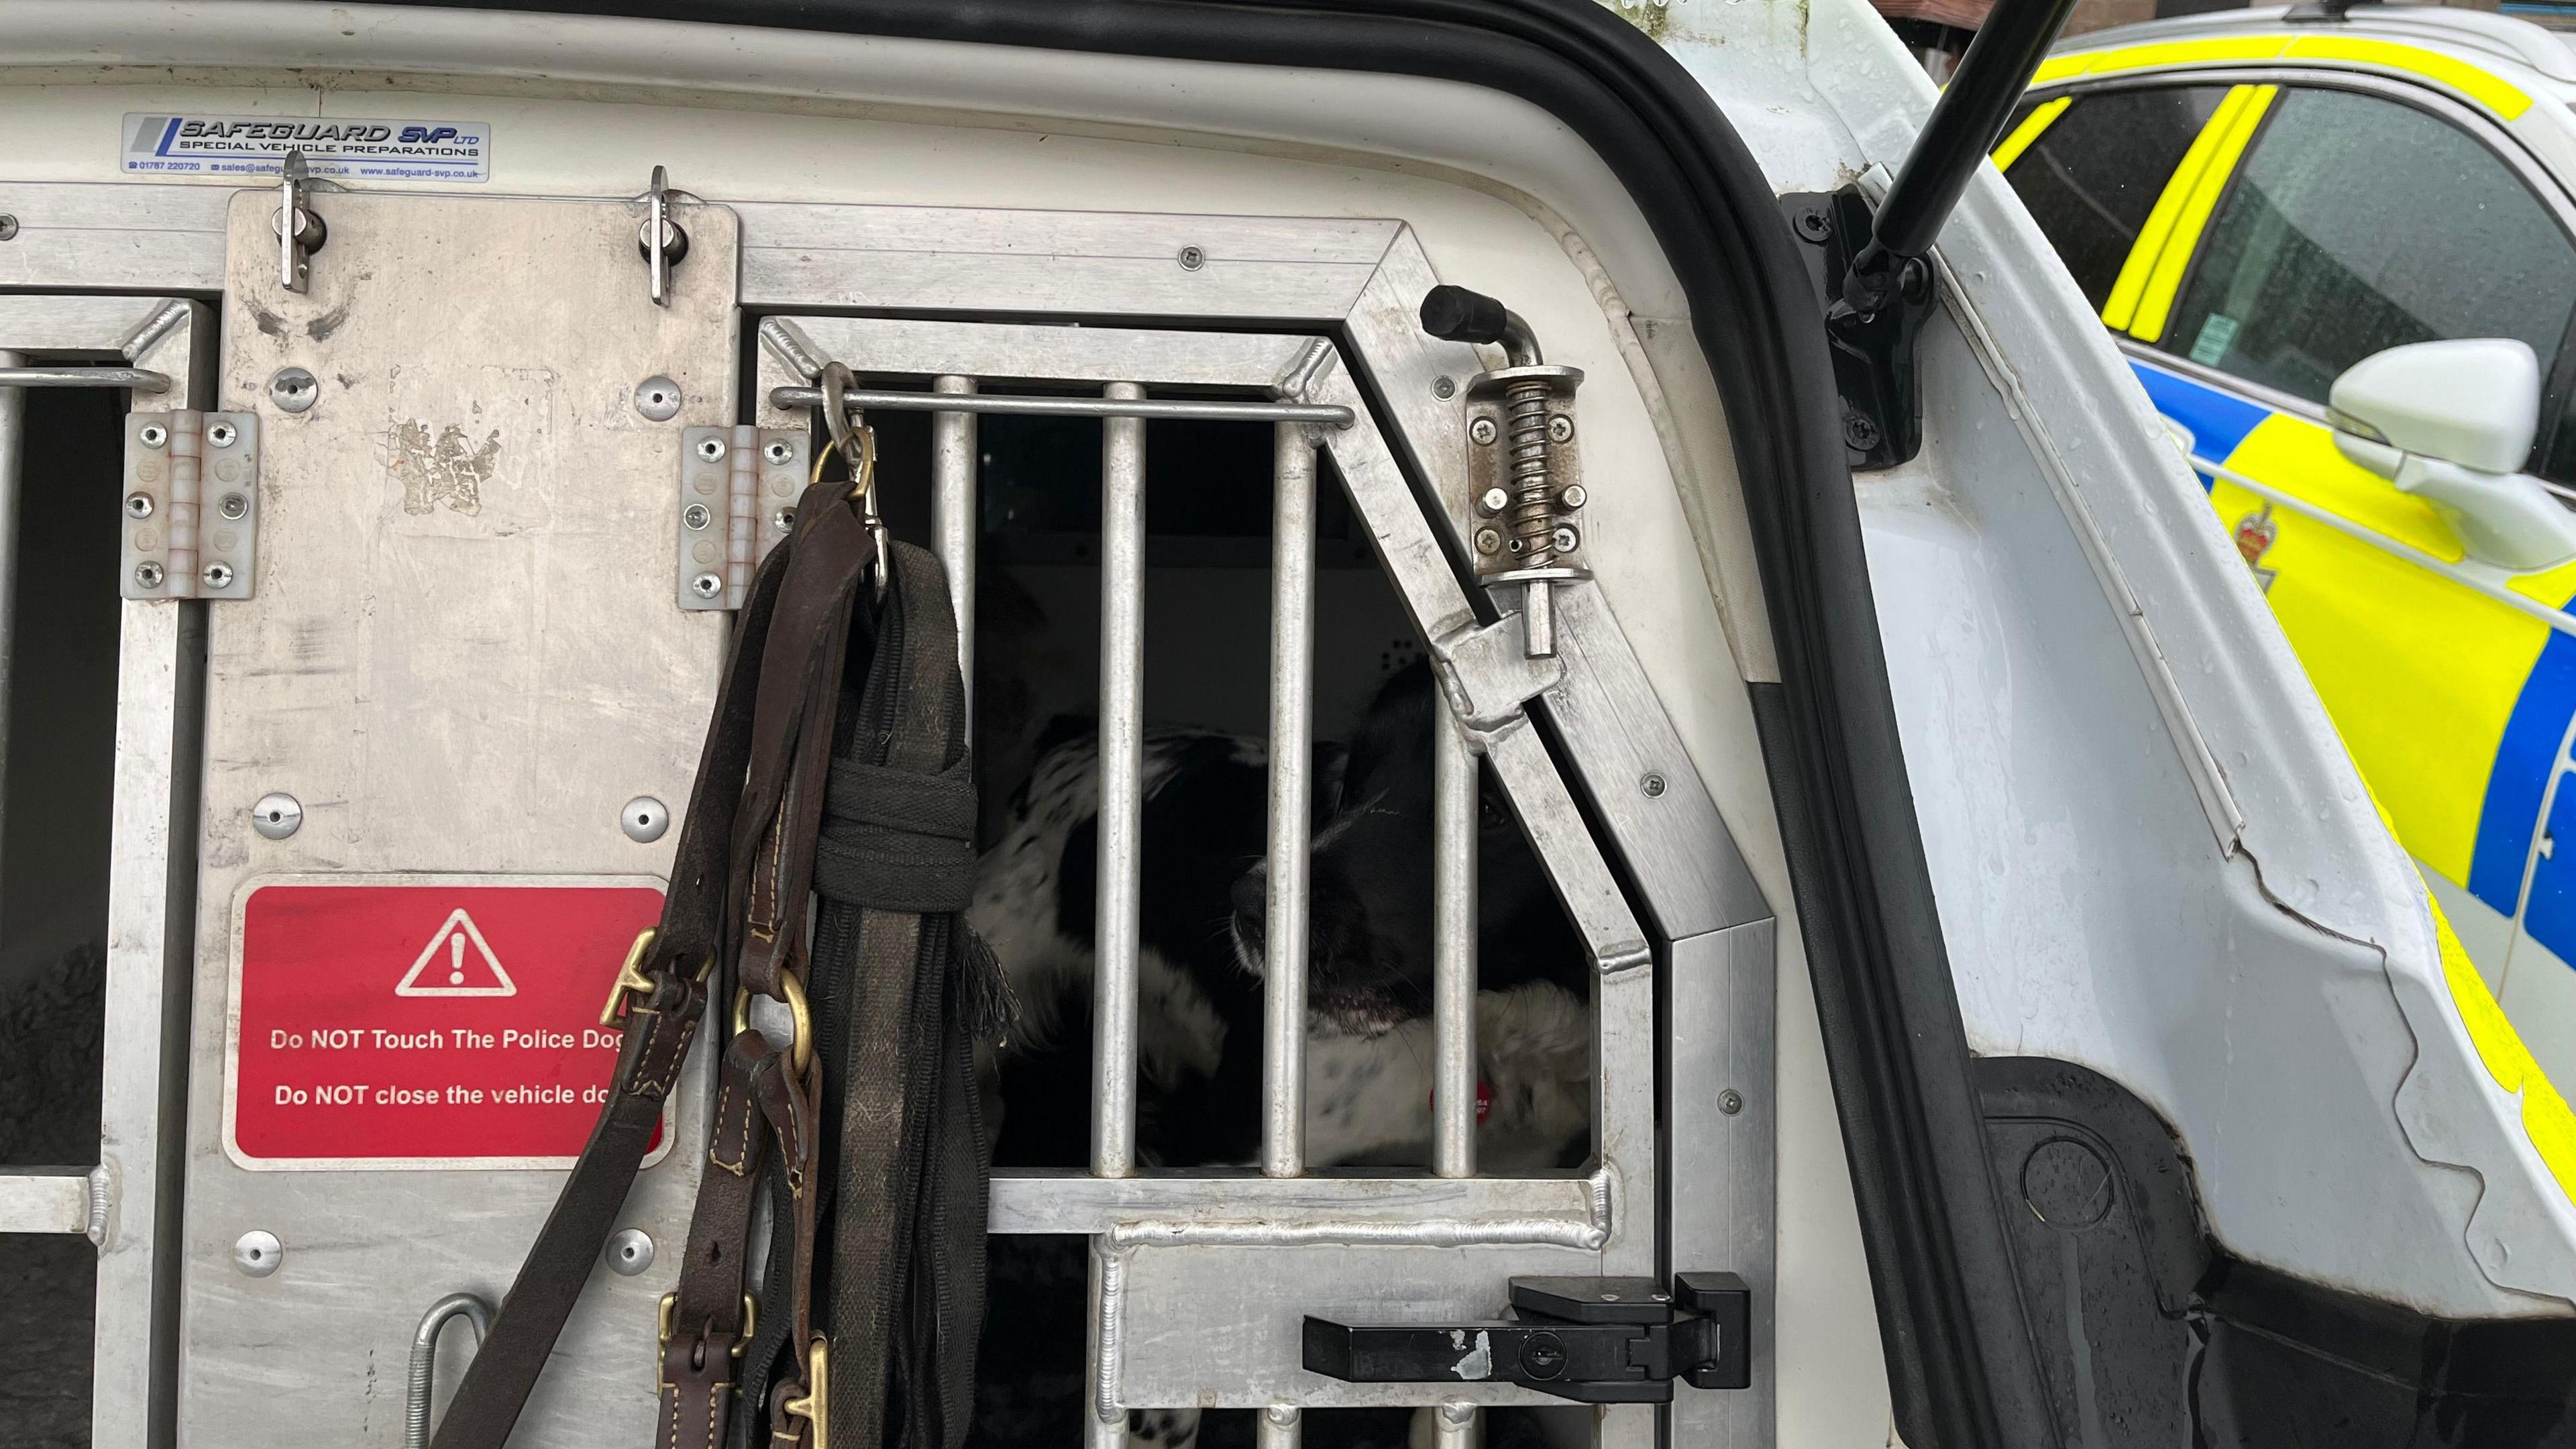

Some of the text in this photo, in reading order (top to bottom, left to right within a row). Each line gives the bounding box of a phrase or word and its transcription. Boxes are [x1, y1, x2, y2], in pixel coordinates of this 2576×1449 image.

[180, 120, 479, 145] SAFEGUARD SVP LTD
[180, 141, 478, 157] SPECIAL VEHICLE PREPARATIONS
[139, 161, 478, 179] 01787 220720 sales@safeguvp.co.uk www.safeguard-svp.co.uk
[270, 1029, 304, 1049] Do
[311, 1029, 365, 1049] NOT
[370, 1029, 443, 1049] Touch
[451, 1029, 495, 1049] The
[502, 1029, 575, 1049] Police
[275, 1084, 609, 1106] Do NOT close the vehicle do
